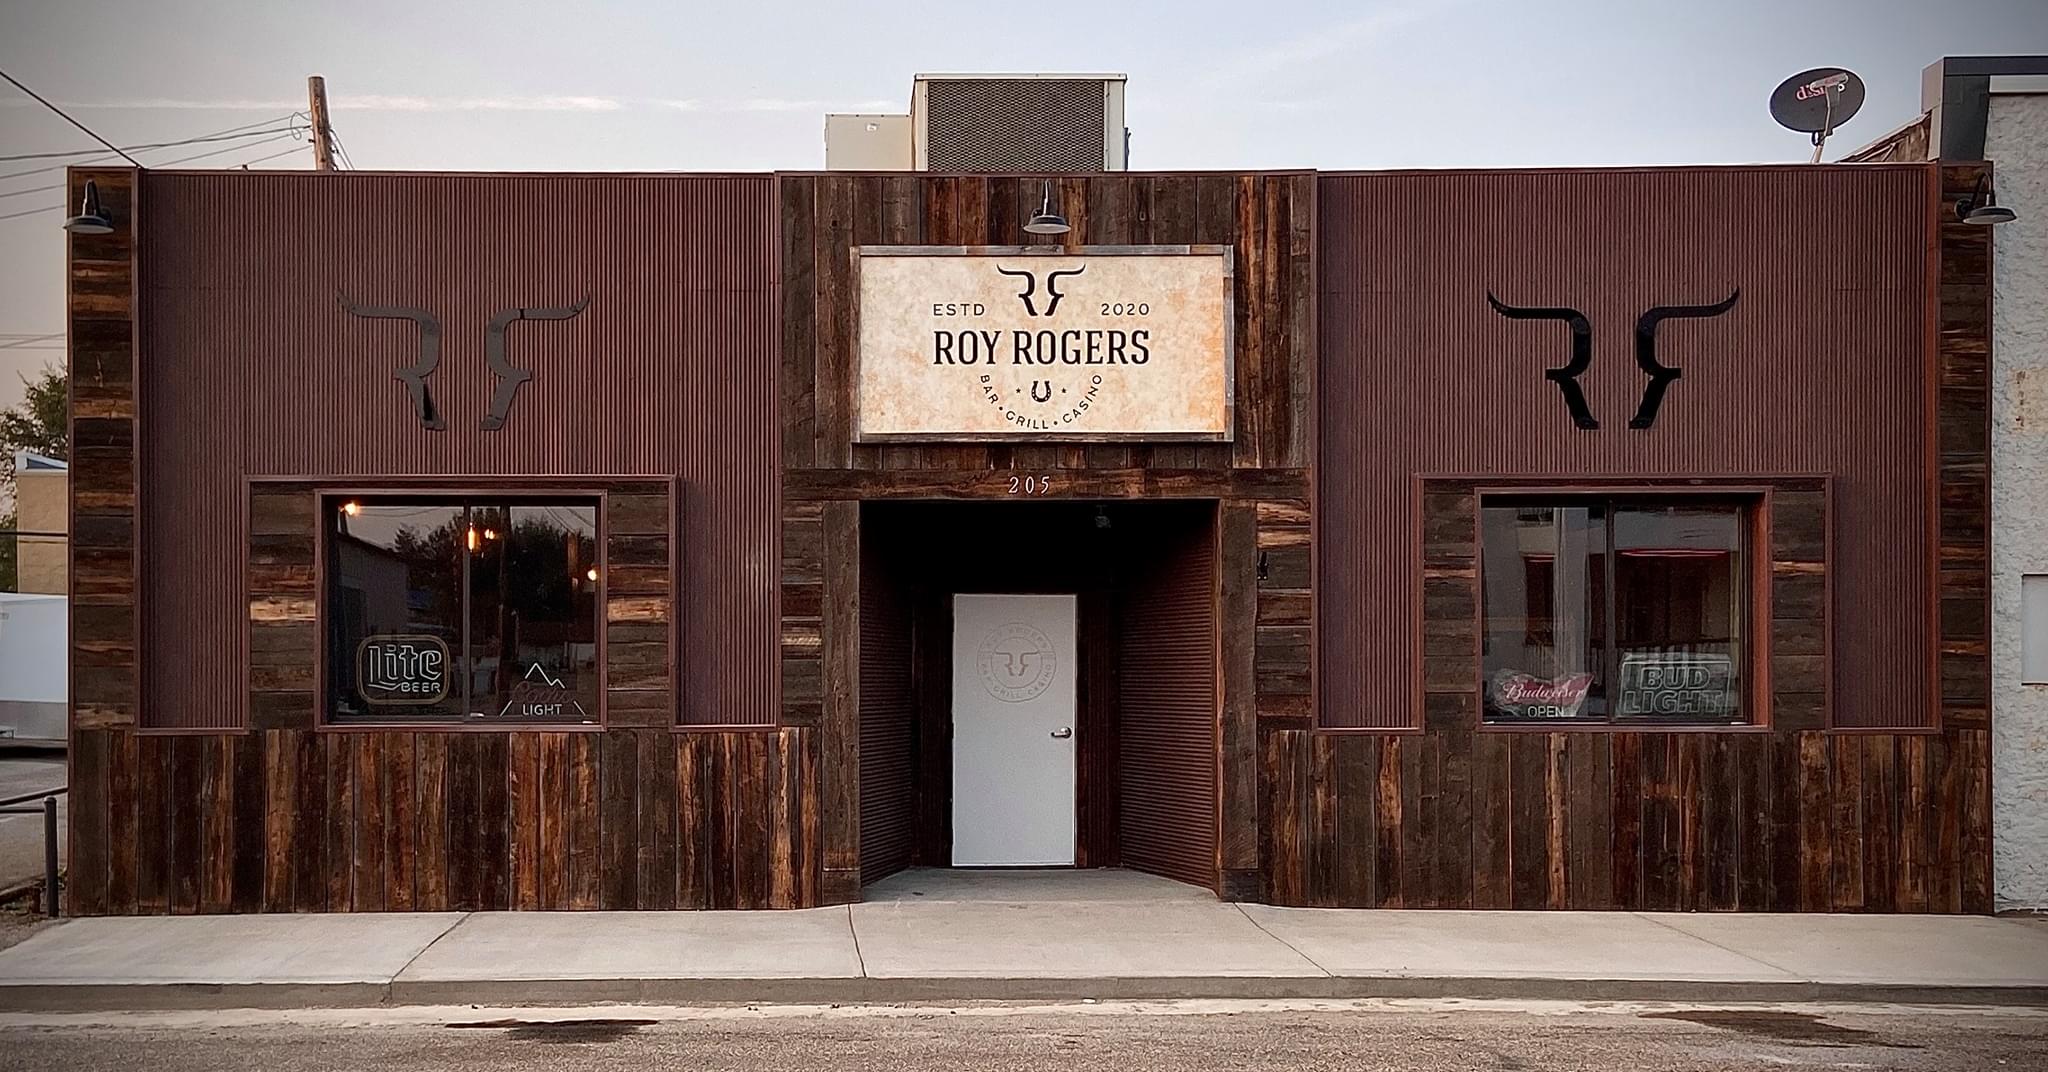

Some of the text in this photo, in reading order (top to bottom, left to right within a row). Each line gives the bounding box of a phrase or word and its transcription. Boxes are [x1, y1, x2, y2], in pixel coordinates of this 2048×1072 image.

[933, 303, 985, 316] ESTD
[1101, 303, 1150, 316] 2020
[933, 330, 1149, 365] ROY ROGERS
[980, 375, 1102, 429] BAR GRILL CASINO
[1008, 476, 1050, 494] 205
[368, 644, 442, 691] Lite
[401, 682, 441, 693] BEER
[1640, 666, 1711, 690] BUD
[1502, 680, 1585, 702] Budweiser
[522, 704, 562, 716] LIGHT
[1527, 705, 1564, 718] OPEN
[1624, 690, 1723, 713] LIGHT
